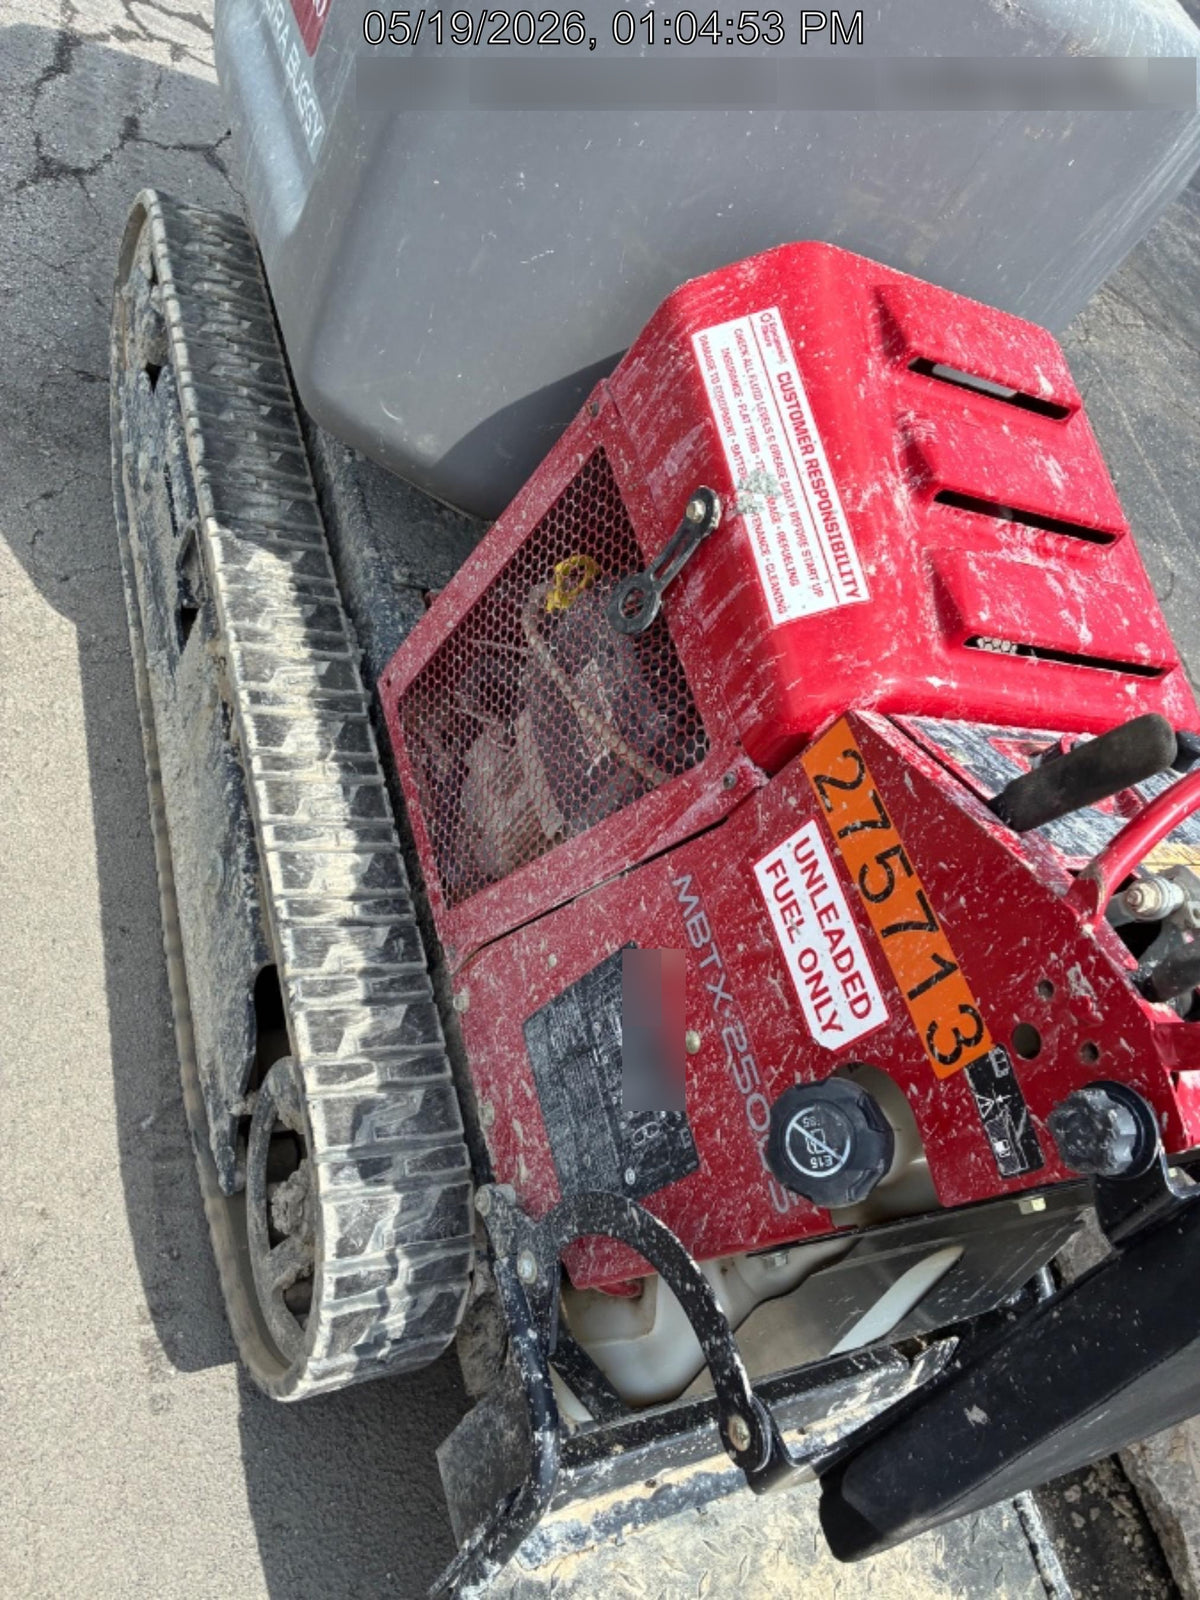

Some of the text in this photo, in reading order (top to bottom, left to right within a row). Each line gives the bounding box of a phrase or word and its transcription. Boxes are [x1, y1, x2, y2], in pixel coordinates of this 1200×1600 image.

[699, 335, 716, 371] DAMAGE
[710, 373, 720, 384] TO
[714, 386, 736, 437] EQUIPMENT
[722, 348, 743, 398] INSURANCE
[738, 404, 751, 424] FLAT
[745, 426, 760, 453] TIRES
[777, 531, 800, 586] REFUELING
[731, 444, 750, 484] BATTER
[735, 328, 750, 357] CHECK
[744, 358, 754, 372] ALL
[749, 374, 763, 400] FLUID
[757, 402, 773, 433] LEVELS
[770, 444, 787, 479] GREASE
[782, 482, 796, 509] DAILY
[791, 512, 808, 547] BEFORE
[802, 550, 818, 581] START
[812, 583, 824, 598] UP
[778, 371, 860, 598] CUSTOMER RESPONSIBILITY
[767, 563, 789, 614] CLEANING
[764, 858, 844, 1034] FUEL ONLY
[791, 836, 872, 1020] UNLEADED
[813, 748, 984, 1066] 275713
[810, 1155, 834, 1169] E15
